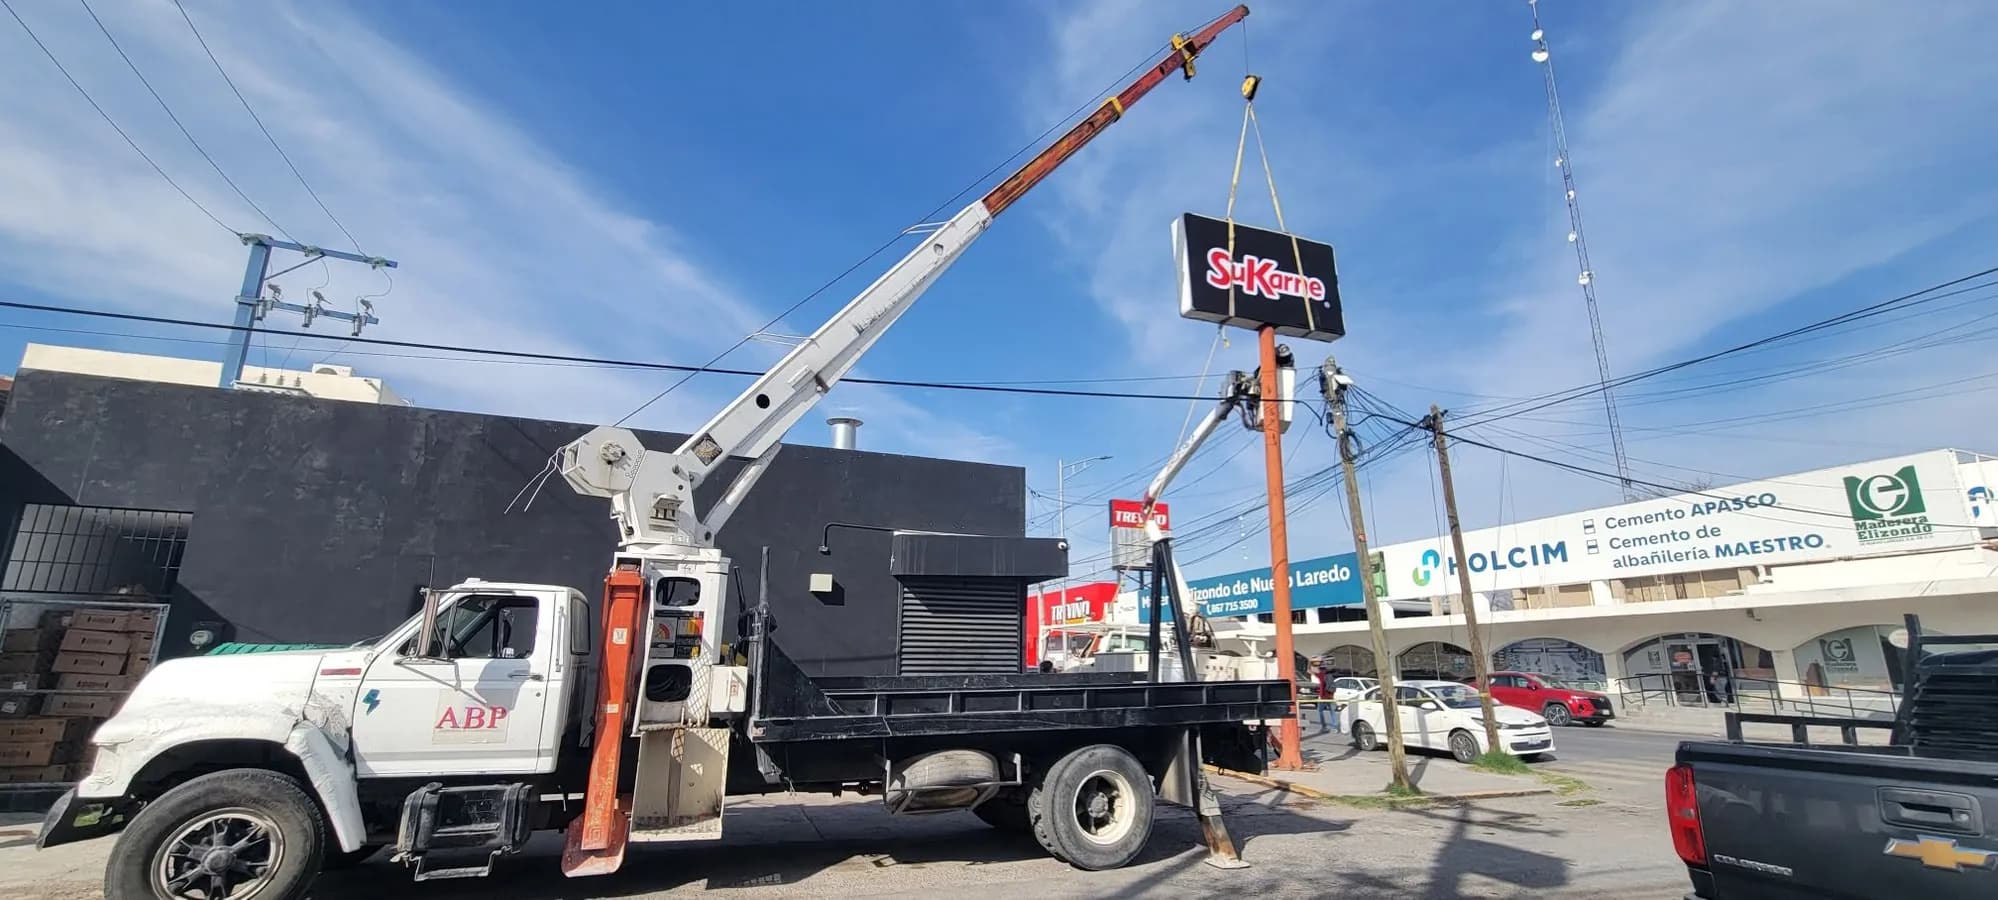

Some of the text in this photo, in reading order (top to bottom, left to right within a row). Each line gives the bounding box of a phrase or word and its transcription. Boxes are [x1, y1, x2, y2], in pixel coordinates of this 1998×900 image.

[1208, 250, 1324, 298] SuKarne
[1604, 493, 1776, 529] Cemento APASCO
[1855, 515, 1928, 531] Maderera
[1609, 525, 1721, 550] Cemento de
[1858, 523, 1932, 540] Elizondo
[1613, 534, 1824, 569] albañilería MAESTRO
[1233, 580, 1248, 595] de
[1296, 564, 1350, 587] Laredo
[435, 706, 507, 729] ABP
